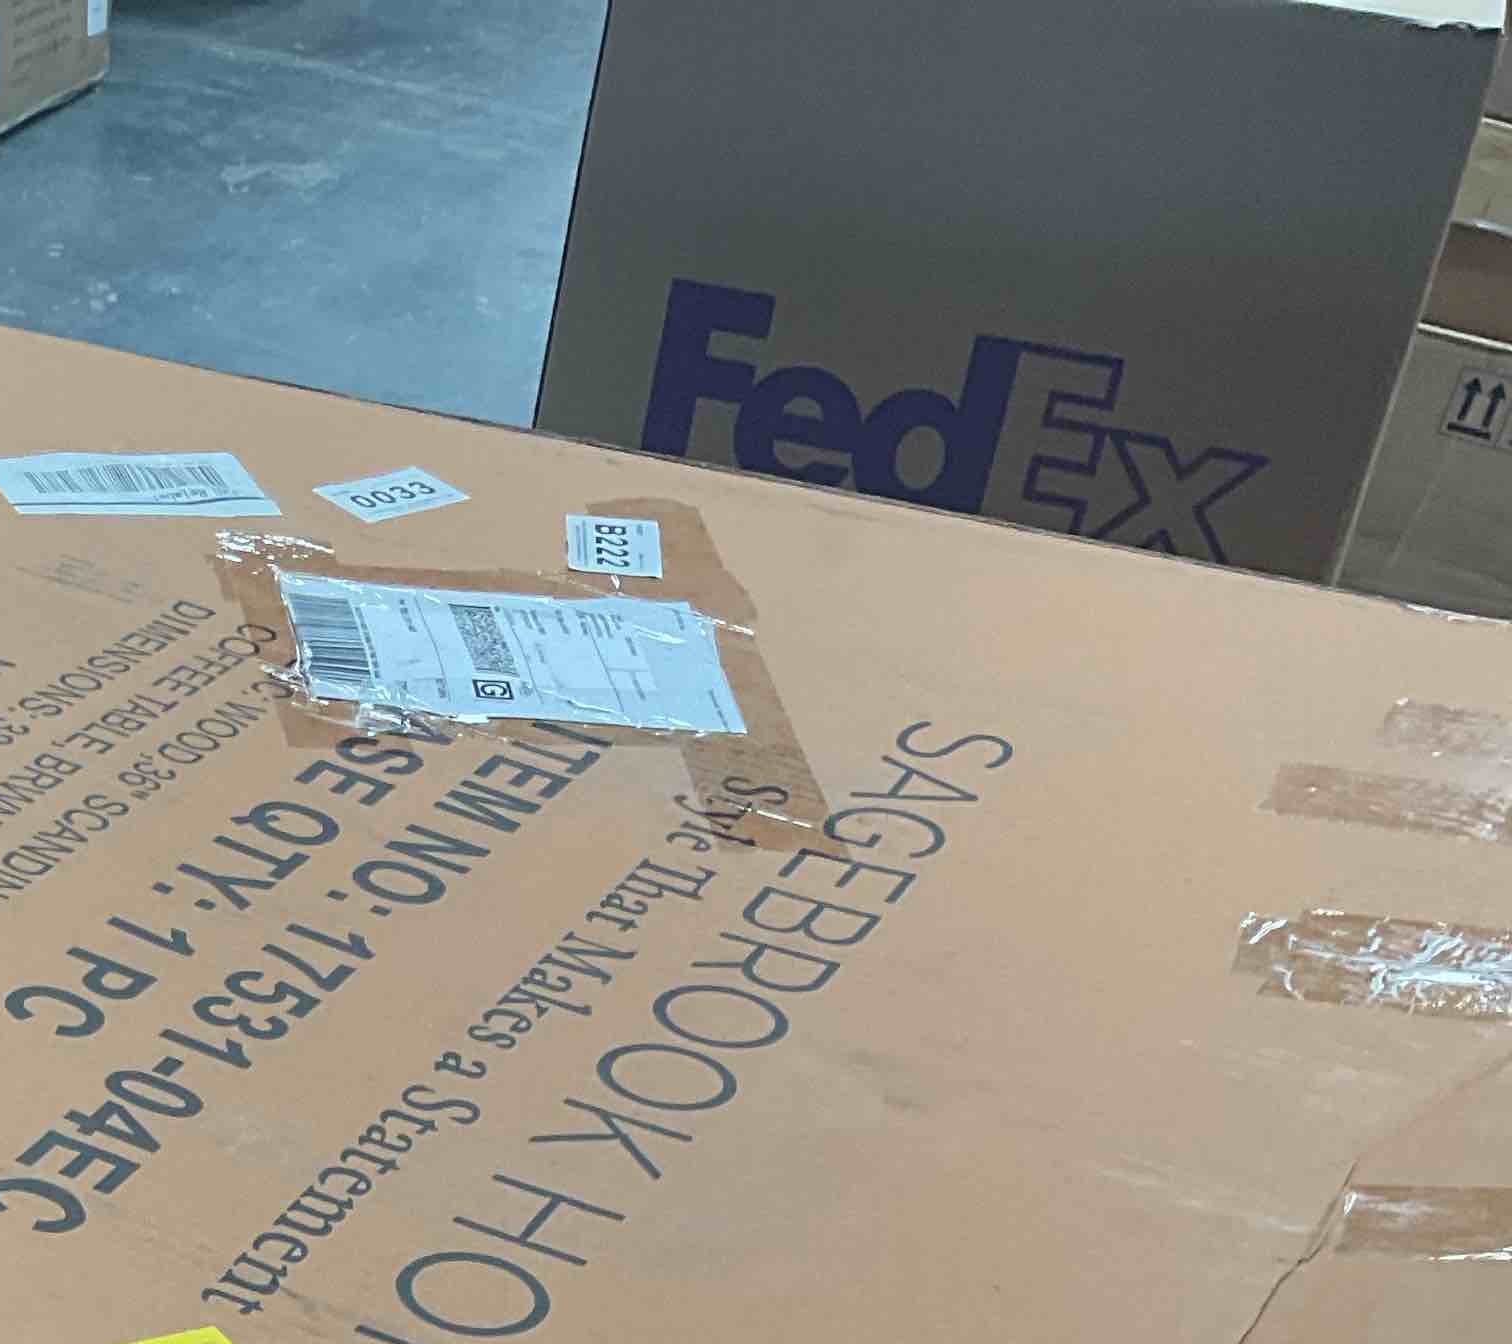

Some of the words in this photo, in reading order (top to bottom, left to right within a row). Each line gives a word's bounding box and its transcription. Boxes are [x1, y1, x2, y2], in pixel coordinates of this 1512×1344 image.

[640, 277, 1271, 564] FedEx
[350, 480, 436, 511] 0033
[594, 524, 630, 568] B222
[8, 600, 217, 719] DIMENSIONS:
[152, 623, 277, 697] COFFEE
[50, 694, 179, 755] TABLE,
[434, 721, 613, 833] ITEM
[665, 775, 789, 852] Style
[151, 801, 339, 911] QTY:
[326, 824, 491, 917] NO:
[586, 857, 719, 932] That
[106, 916, 195, 957] 1
[528, 720, 1014, 1180] SAGEBROOK
[4, 946, 158, 1038] PC
[467, 930, 636, 1050] Makes
[434, 1050, 487, 1081] a
[201, 1084, 480, 1315] Statement
